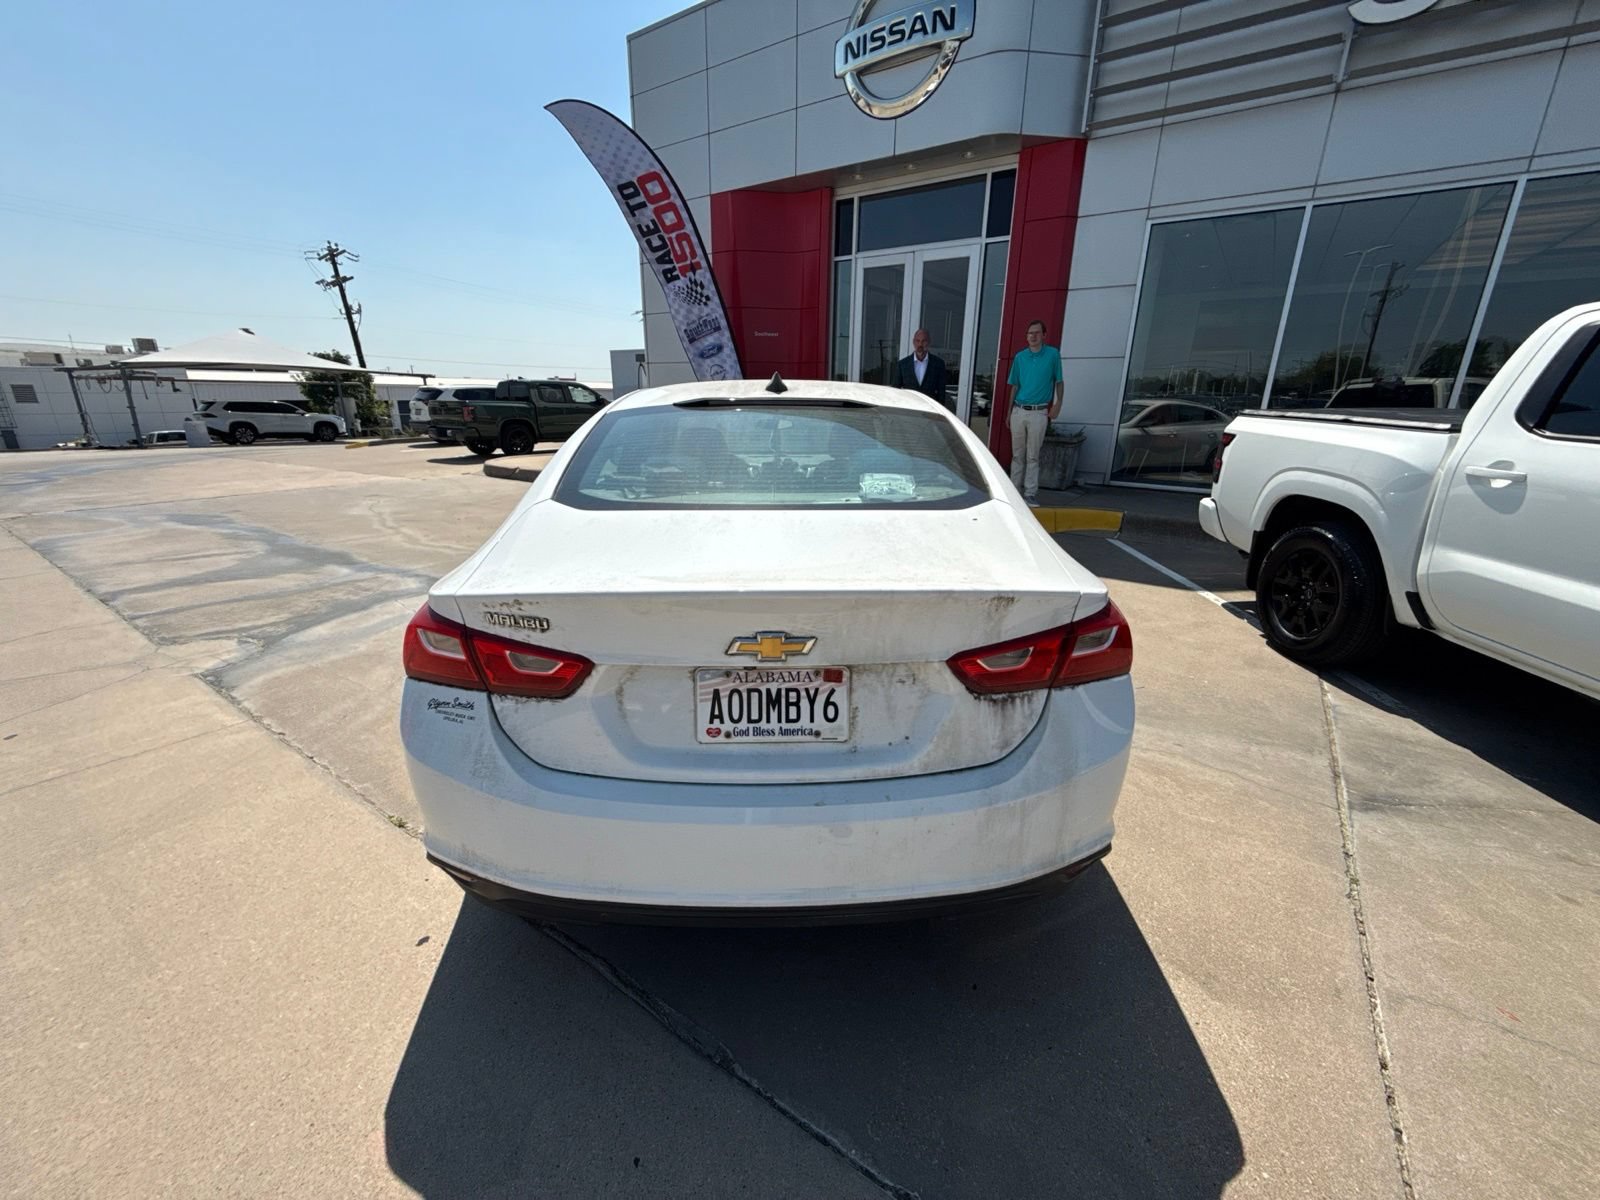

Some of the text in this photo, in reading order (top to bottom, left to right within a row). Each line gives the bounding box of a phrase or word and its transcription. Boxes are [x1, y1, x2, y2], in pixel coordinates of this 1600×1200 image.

[844, 5, 957, 65] NISSAN
[617, 180, 681, 284] RACE TO
[636, 170, 703, 279] 1500
[485, 612, 551, 633] MALIBU
[732, 671, 814, 683] ALABAMA
[452, 696, 475, 710] Smith
[732, 726, 749, 737] God
[752, 726, 776, 737] Bless
[779, 725, 814, 737] America
